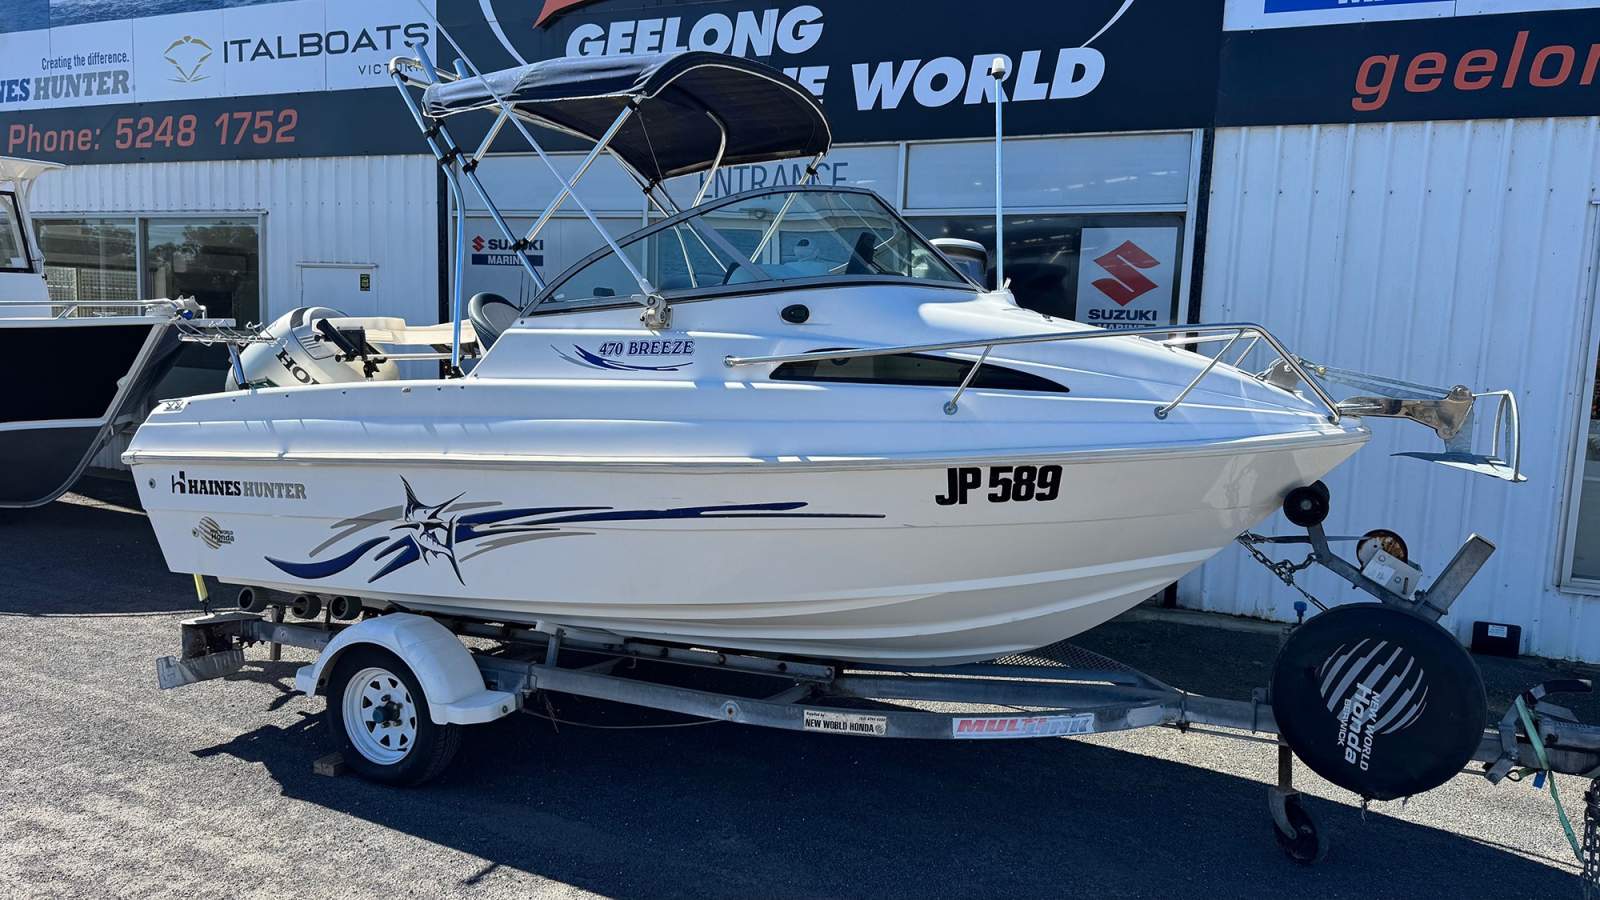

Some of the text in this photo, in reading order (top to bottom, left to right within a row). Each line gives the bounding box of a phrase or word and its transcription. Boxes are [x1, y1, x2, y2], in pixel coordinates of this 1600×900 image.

[224, 22, 429, 64] ITALBOATS
[566, 5, 824, 58] GEELONG
[42, 51, 130, 70] Creating the difference.
[33, 70, 130, 101] HUNTER
[852, 46, 1106, 111] WORLD
[8, 109, 298, 154] Phone: 5248 1752
[488, 239, 543, 251] SUKI
[488, 255, 525, 265] MARIN
[1088, 309, 1157, 321] SUZUKI
[600, 340, 694, 356] 470 BREEZE
[189, 480, 307, 499] HAINES HUNTER
[935, 465, 1063, 505] JP 589
[804, 718, 875, 733] NEW WORLD HONDA
[1344, 682, 1372, 764] Honda
[1360, 690, 1380, 771] NEW WORLD
